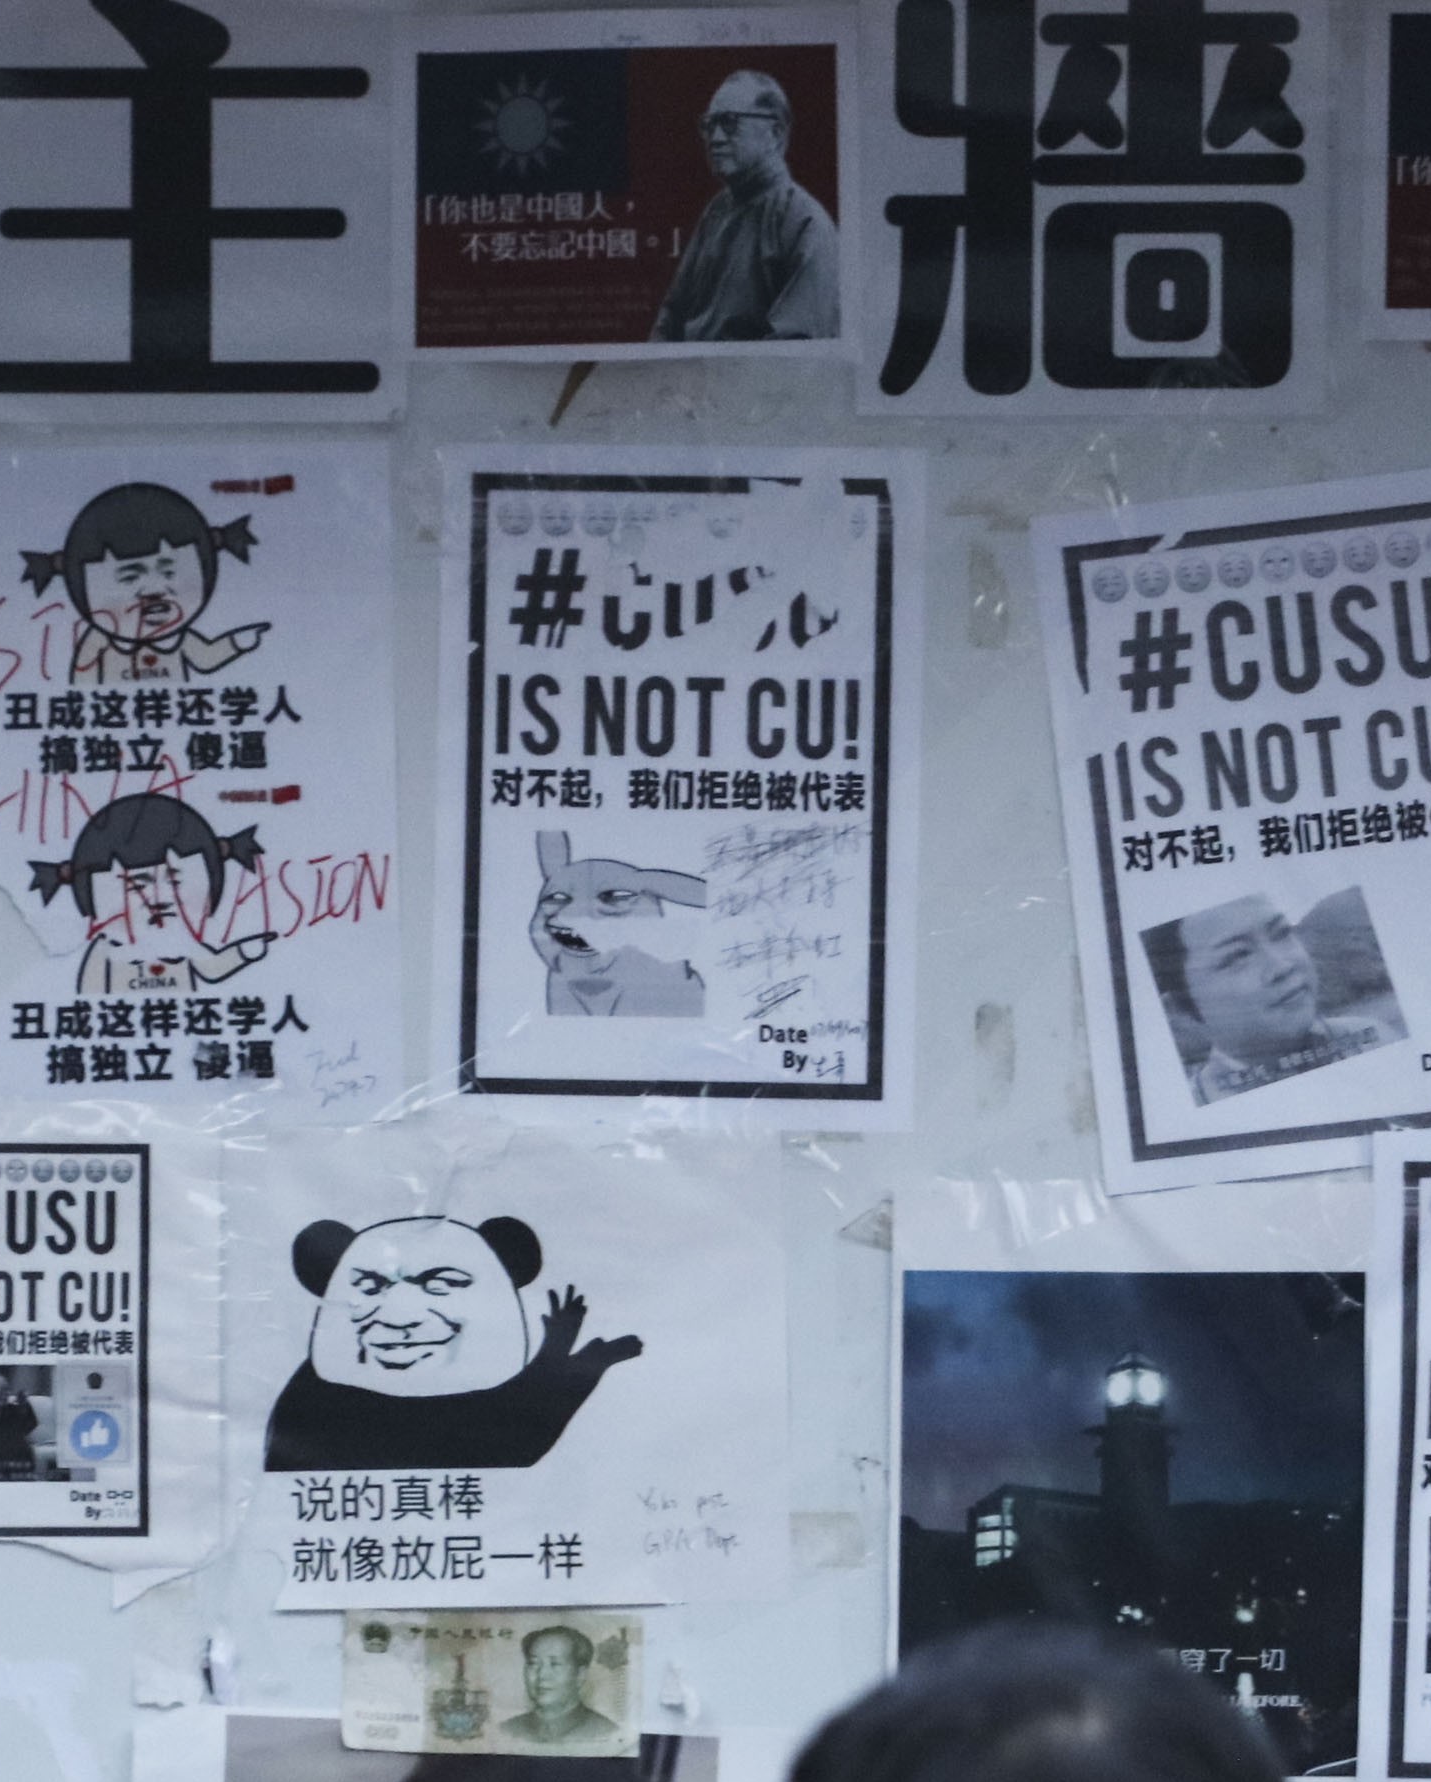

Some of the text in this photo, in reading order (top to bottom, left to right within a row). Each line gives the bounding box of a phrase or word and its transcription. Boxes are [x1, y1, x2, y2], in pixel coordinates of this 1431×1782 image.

[880, 0, 1306, 396] 牆
[4, 686, 301, 731] 丑成这样还学人
[496, 674, 860, 760] IS NOT CU!
[41, 731, 268, 775] 搞独立 傻逼
[1114, 736, 1184, 822] IS
[1200, 717, 1341, 811] NOT
[492, 768, 865, 811] 对不起，我们拒绝被代表
[11, 995, 309, 1042] 丑成这样还学人
[759, 1025, 808, 1042] Date
[47, 1043, 171, 1084] 搞独立
[784, 1051, 808, 1073] By
[59, 1272, 130, 1322] CU!
[291, 1475, 484, 1523] 说的真棒
[291, 1533, 582, 1583] 就像放屁一样
